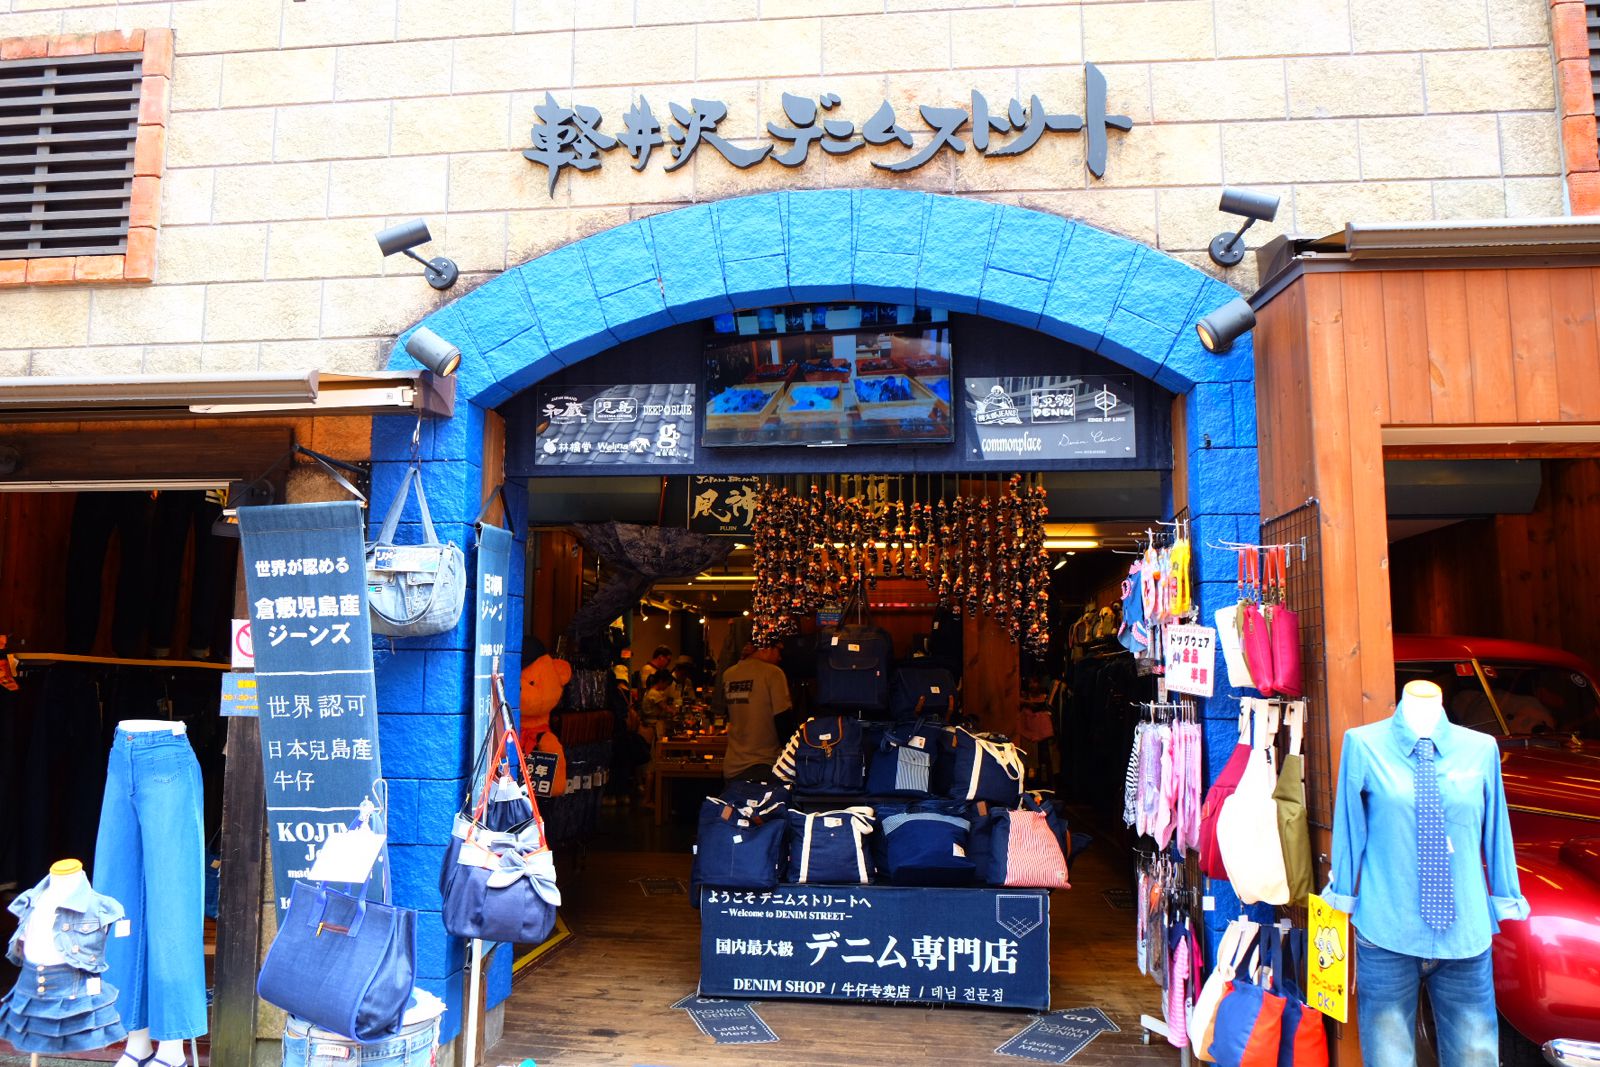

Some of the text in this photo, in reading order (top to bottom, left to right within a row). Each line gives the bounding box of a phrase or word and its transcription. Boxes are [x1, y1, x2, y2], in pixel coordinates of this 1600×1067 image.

[643, 405, 693, 416] DEEP BLUE
[1032, 407, 1075, 418] DENIM
[981, 431, 1042, 456] commonplace
[255, 556, 350, 578] 世界が認める
[254, 593, 361, 620] 倉敷児島産
[268, 622, 351, 647] ジーンズ
[273, 770, 315, 791] 牛仔
[765, 910, 774, 918] to
[775, 910, 807, 920] DENIM
[715, 938, 794, 957] 国内最大級
[805, 930, 1019, 975] デニム専門店
[733, 978, 782, 991] DENIM
[785, 980, 826, 994] SHOP
[841, 982, 911, 999] 牛仔专卖店
[931, 985, 1004, 1002] 데님 전문점
[695, 1007, 746, 1015] KOJIMA
[701, 1011, 747, 1019] DENIM
[1062, 1014, 1097, 1024] GO!
[712, 1024, 757, 1032] Ladie's
[1038, 1027, 1084, 1039] DENIM
[1040, 1022, 1090, 1035] KOJIMA
[1018, 1045, 1057, 1056] Men's
[1022, 1039, 1066, 1051] Ladie's
